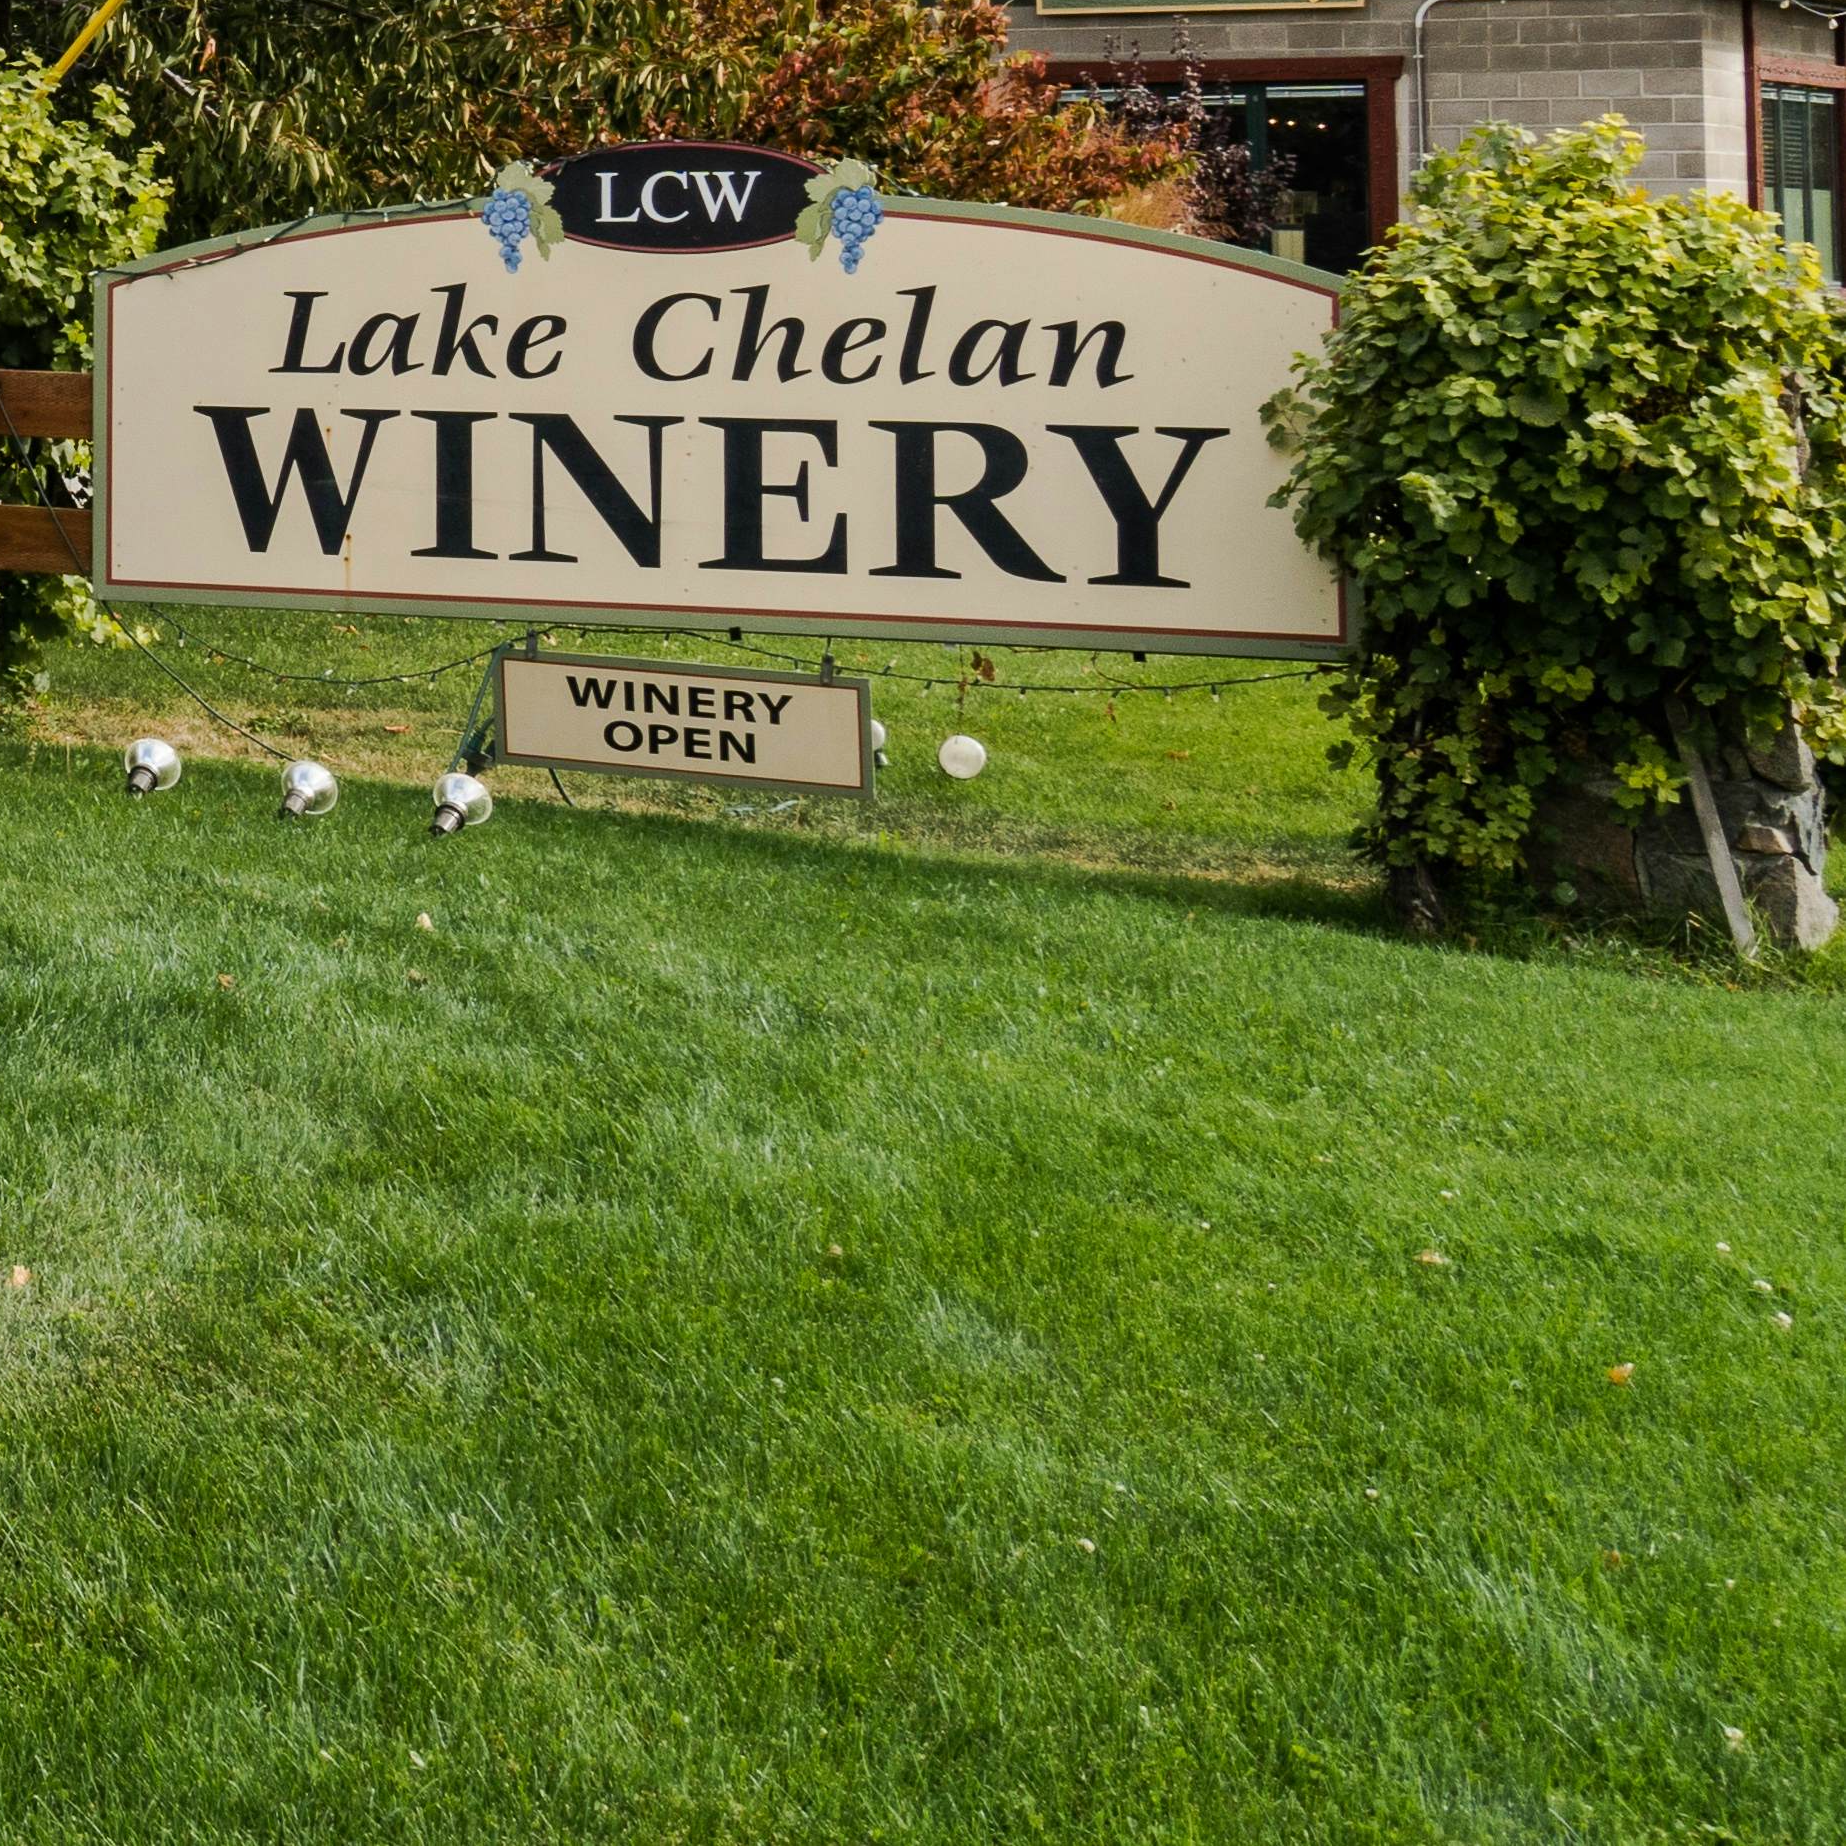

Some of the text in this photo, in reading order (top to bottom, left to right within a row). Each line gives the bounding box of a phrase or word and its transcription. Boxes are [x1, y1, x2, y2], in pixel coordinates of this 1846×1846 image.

[595, 170, 762, 224] LCW
[268, 282, 1134, 389] Lake Chelan
[193, 405, 1231, 589] WINERY
[565, 675, 793, 725] WINERY
[603, 720, 756, 764] OPEN
